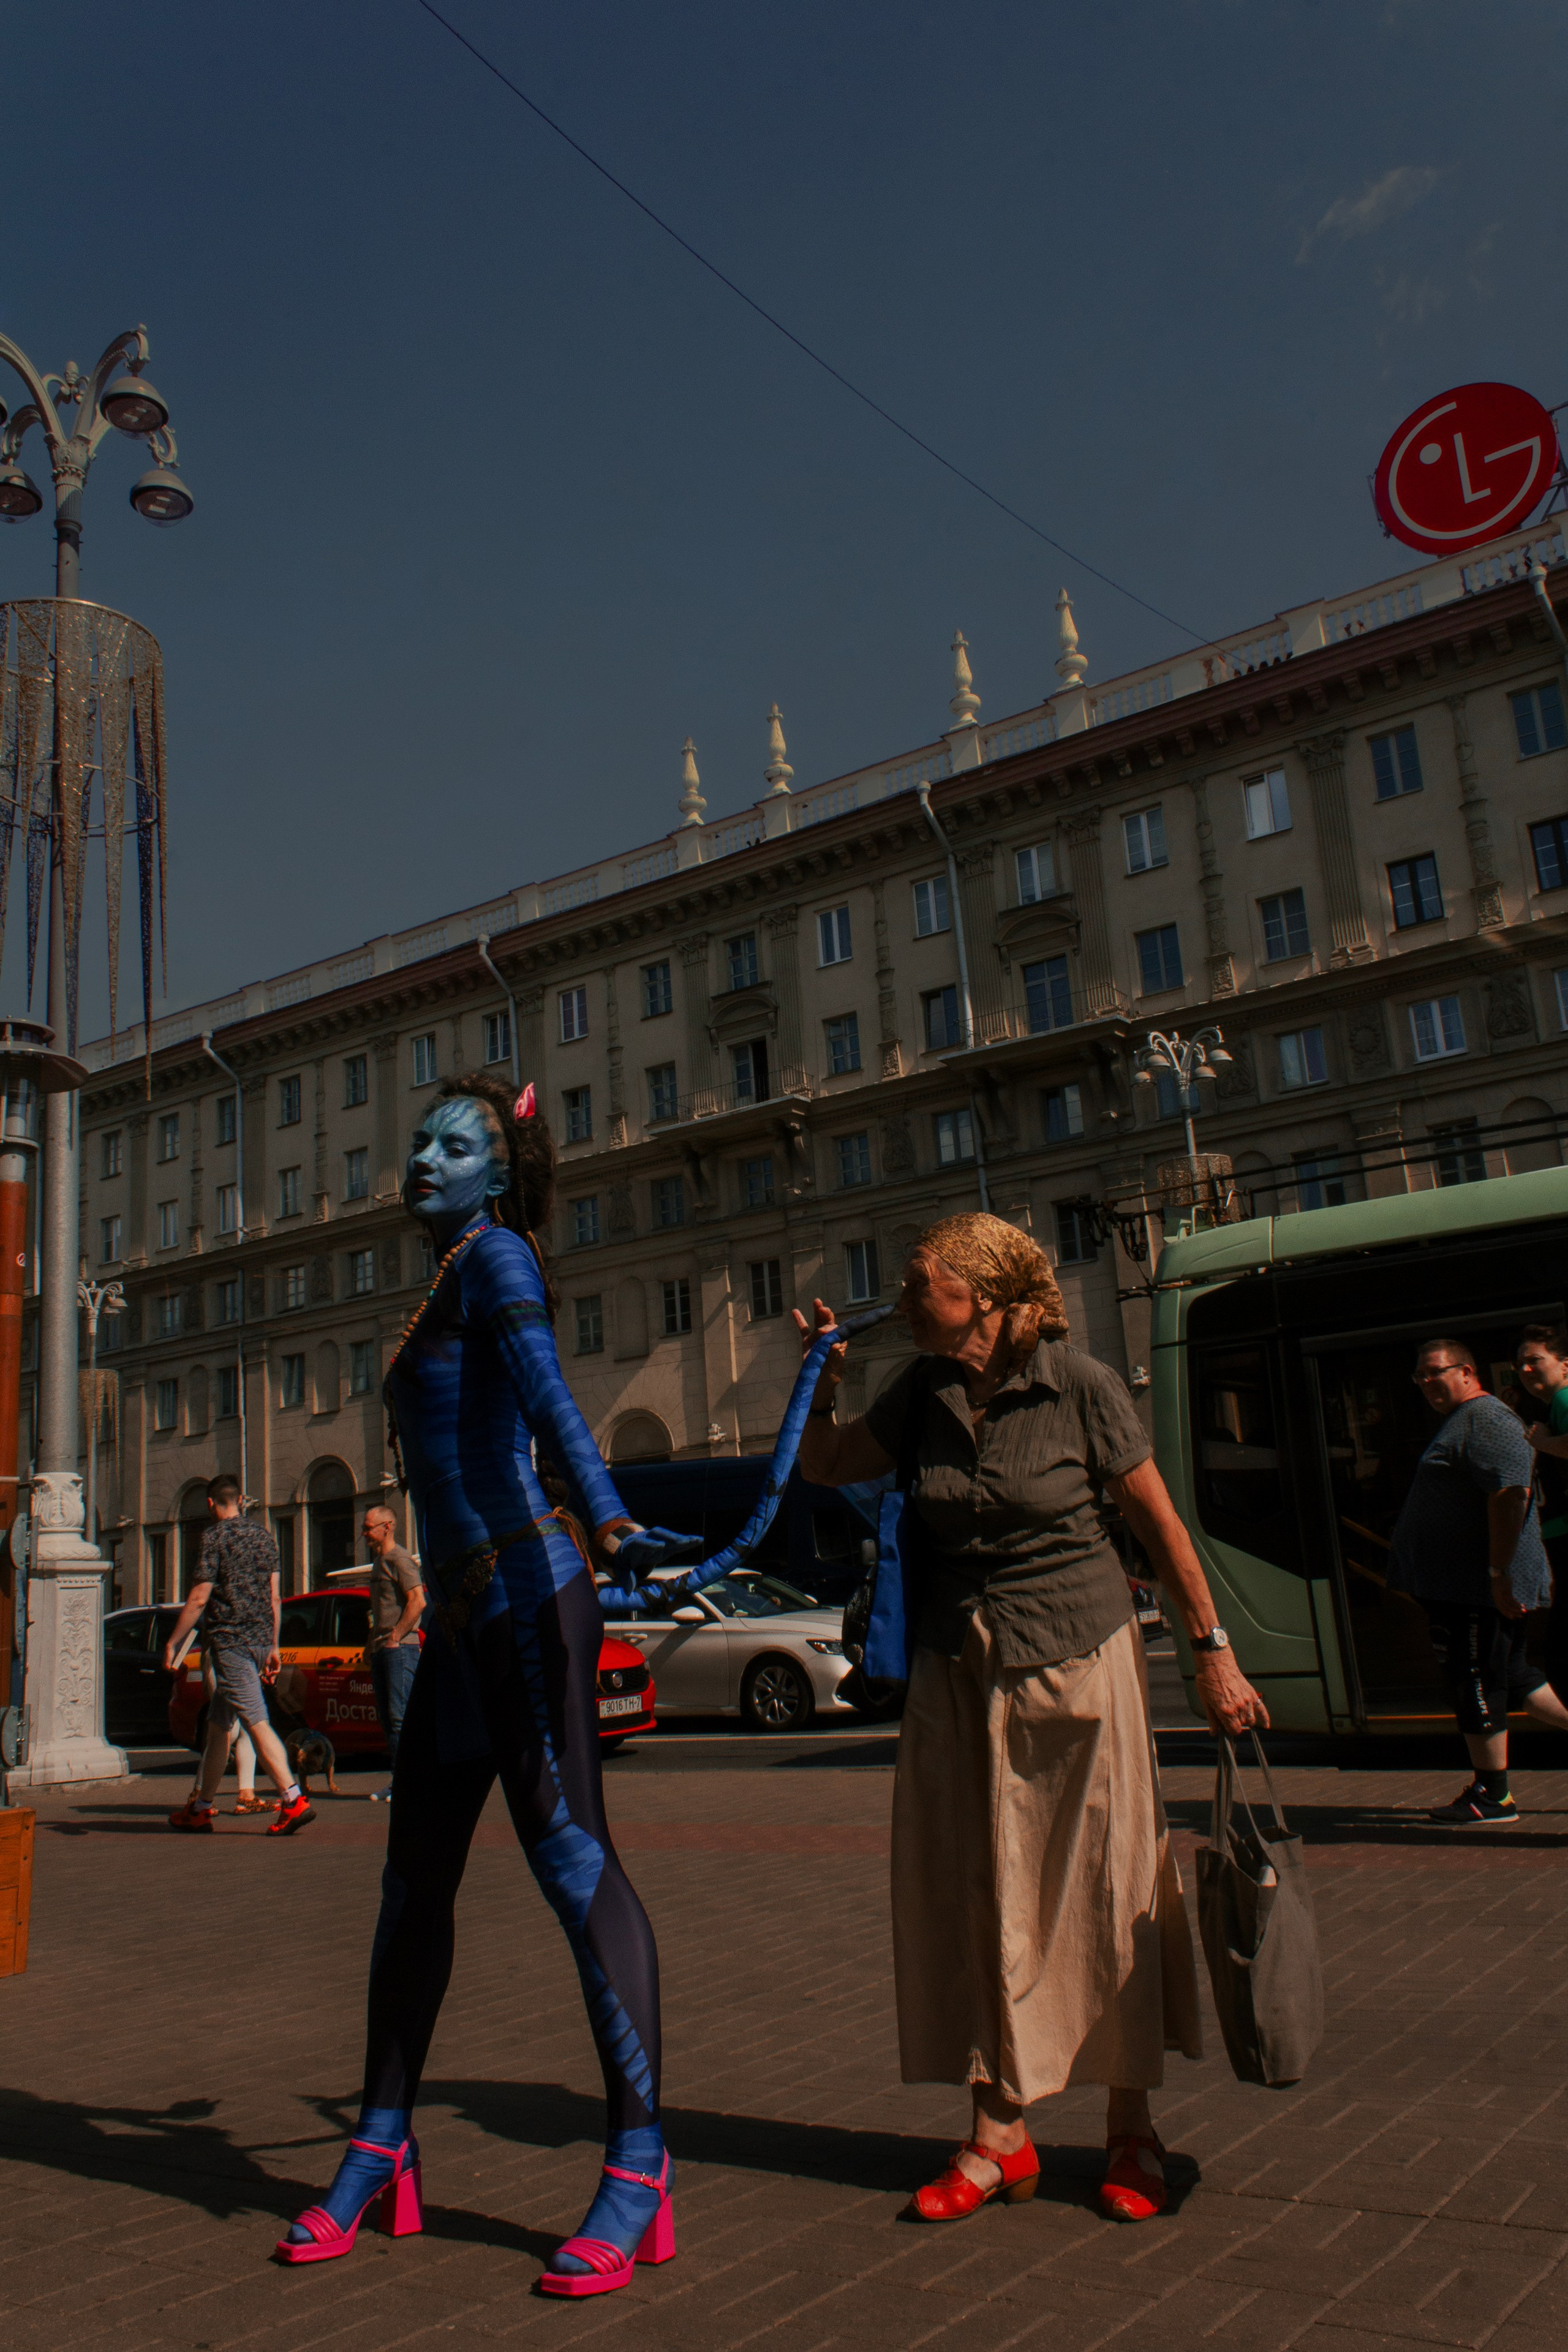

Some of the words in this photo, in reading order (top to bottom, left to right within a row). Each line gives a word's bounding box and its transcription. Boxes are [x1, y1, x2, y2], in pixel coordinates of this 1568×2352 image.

[1388, 401, 1541, 540] LG
[350, 1679, 375, 1695] Янде
[326, 1698, 377, 1722] Доста
[606, 1700, 623, 1713] 9016
